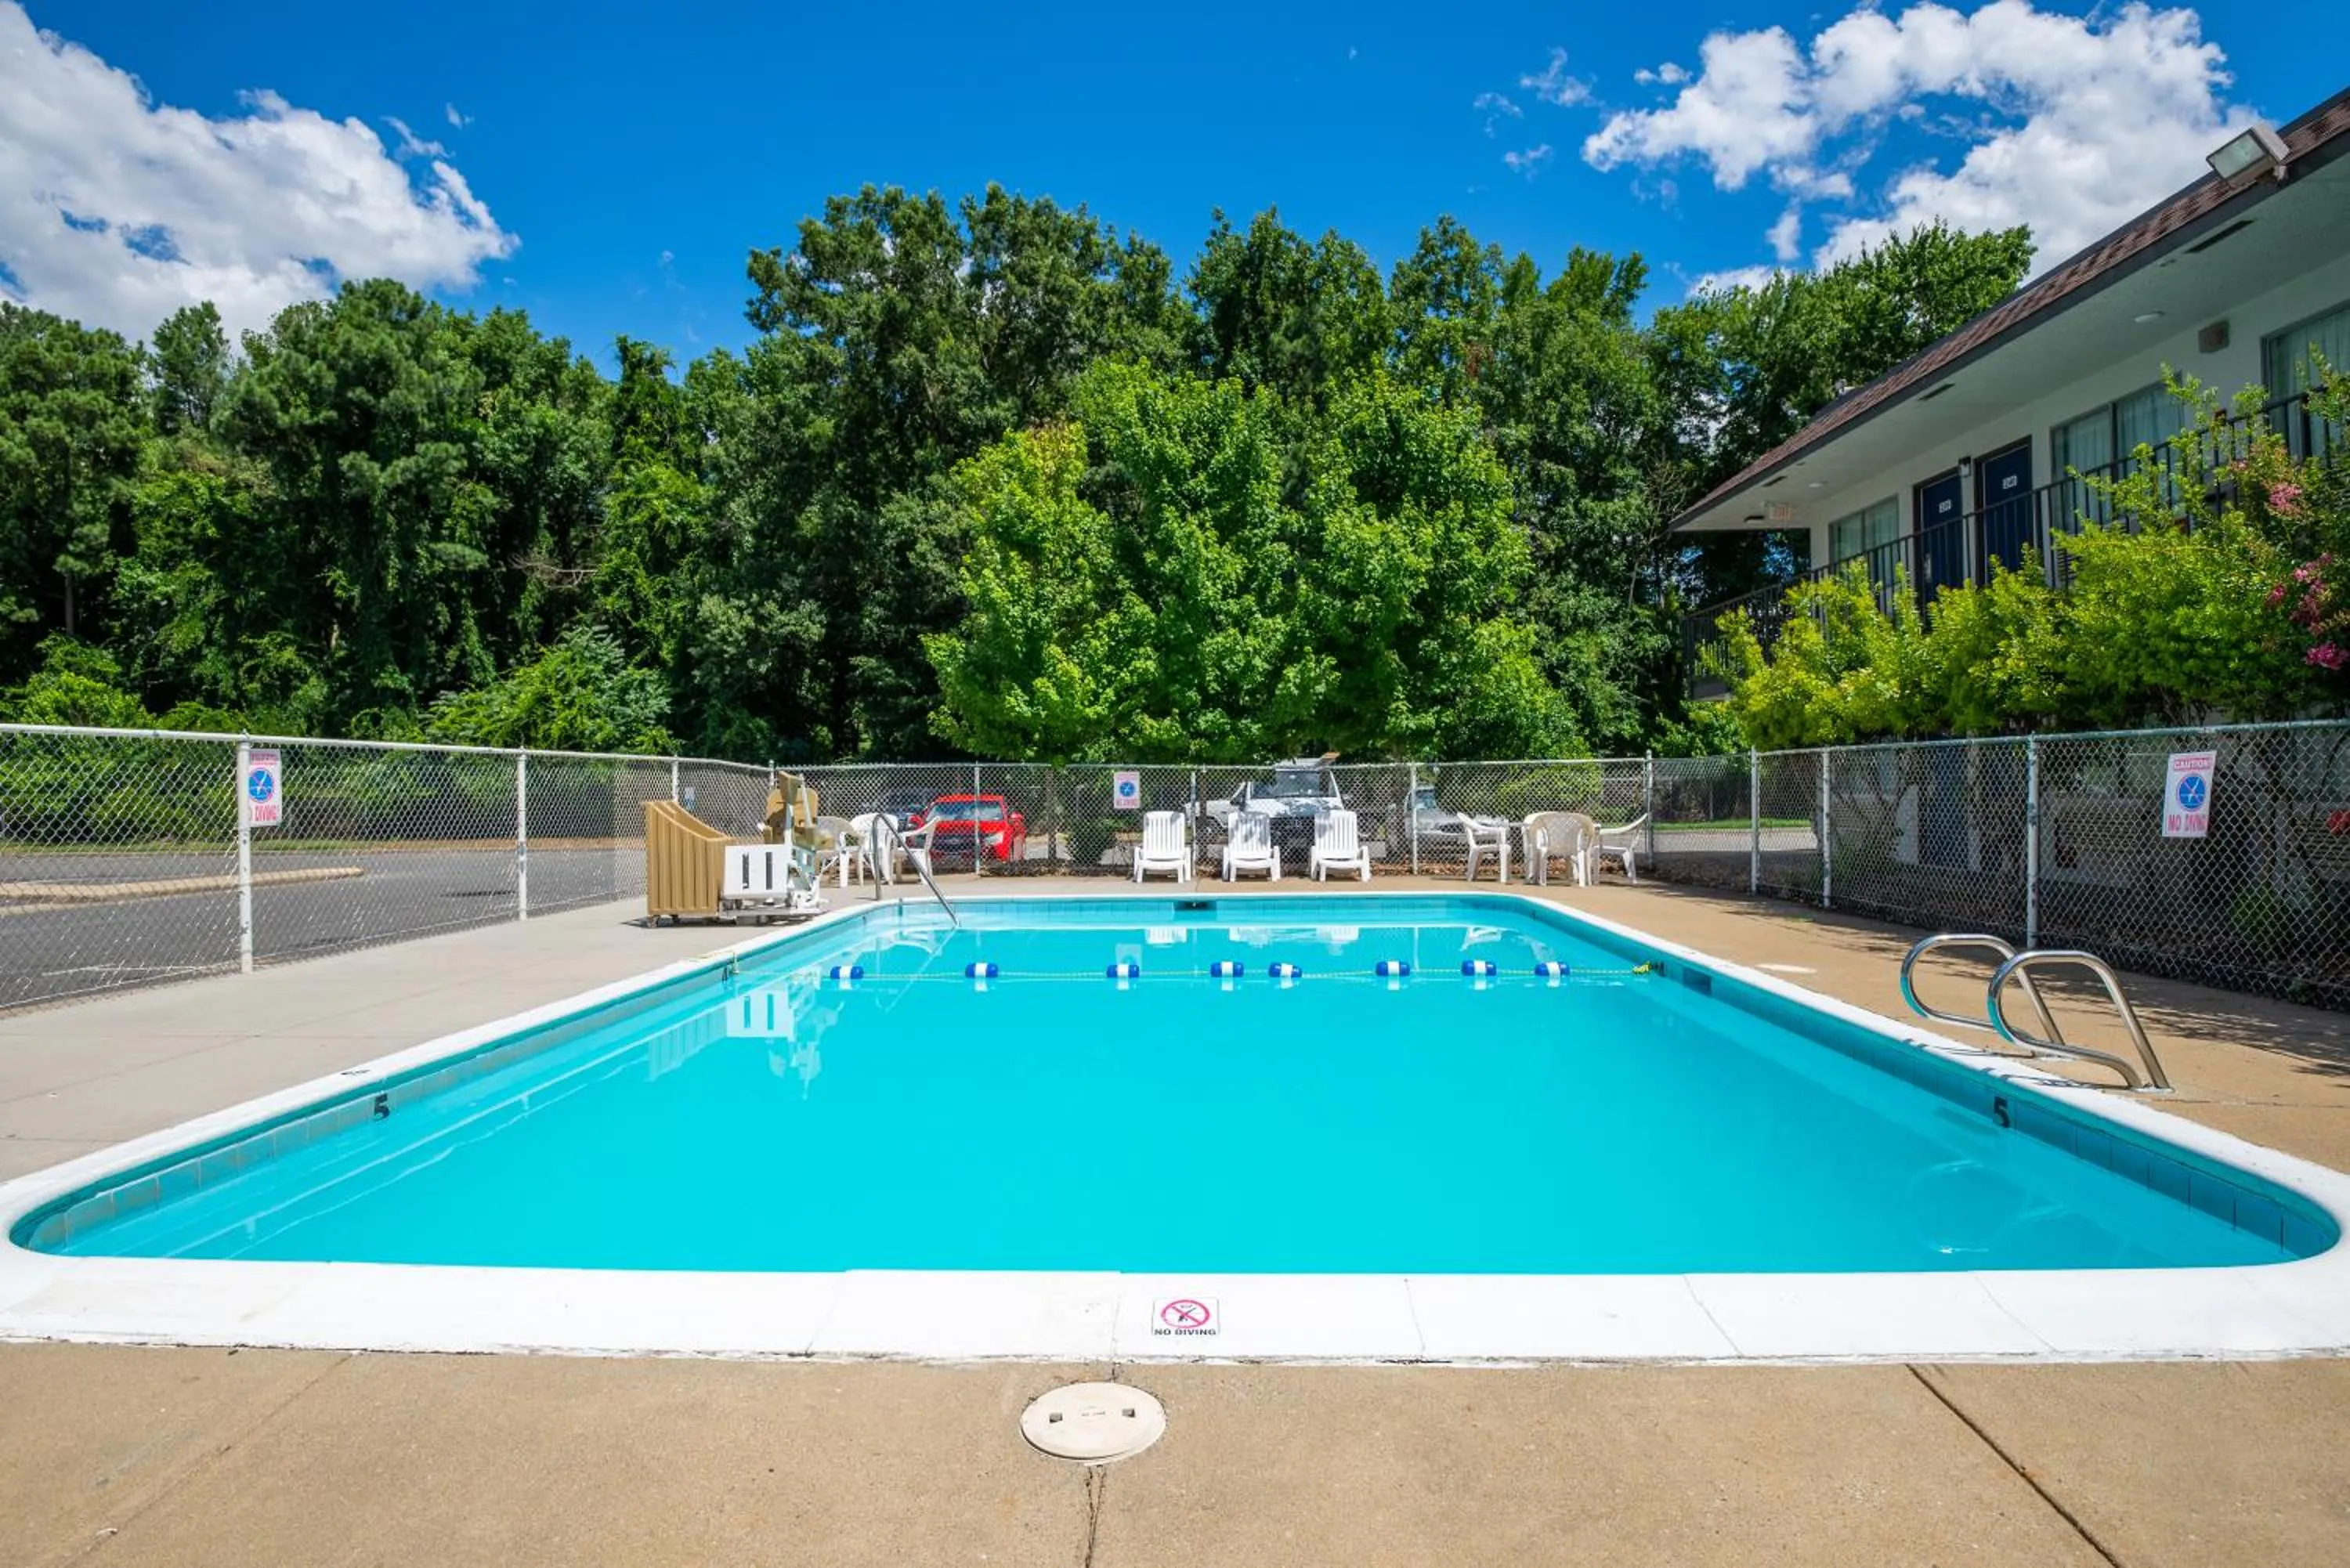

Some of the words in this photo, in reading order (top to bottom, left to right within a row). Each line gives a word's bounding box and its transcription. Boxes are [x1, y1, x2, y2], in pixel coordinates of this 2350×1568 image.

[2175, 757, 2210, 769] CAUTION
[2167, 814, 2182, 833] NO
[374, 1093, 390, 1122] 5
[1994, 1096, 2010, 1129] 5
